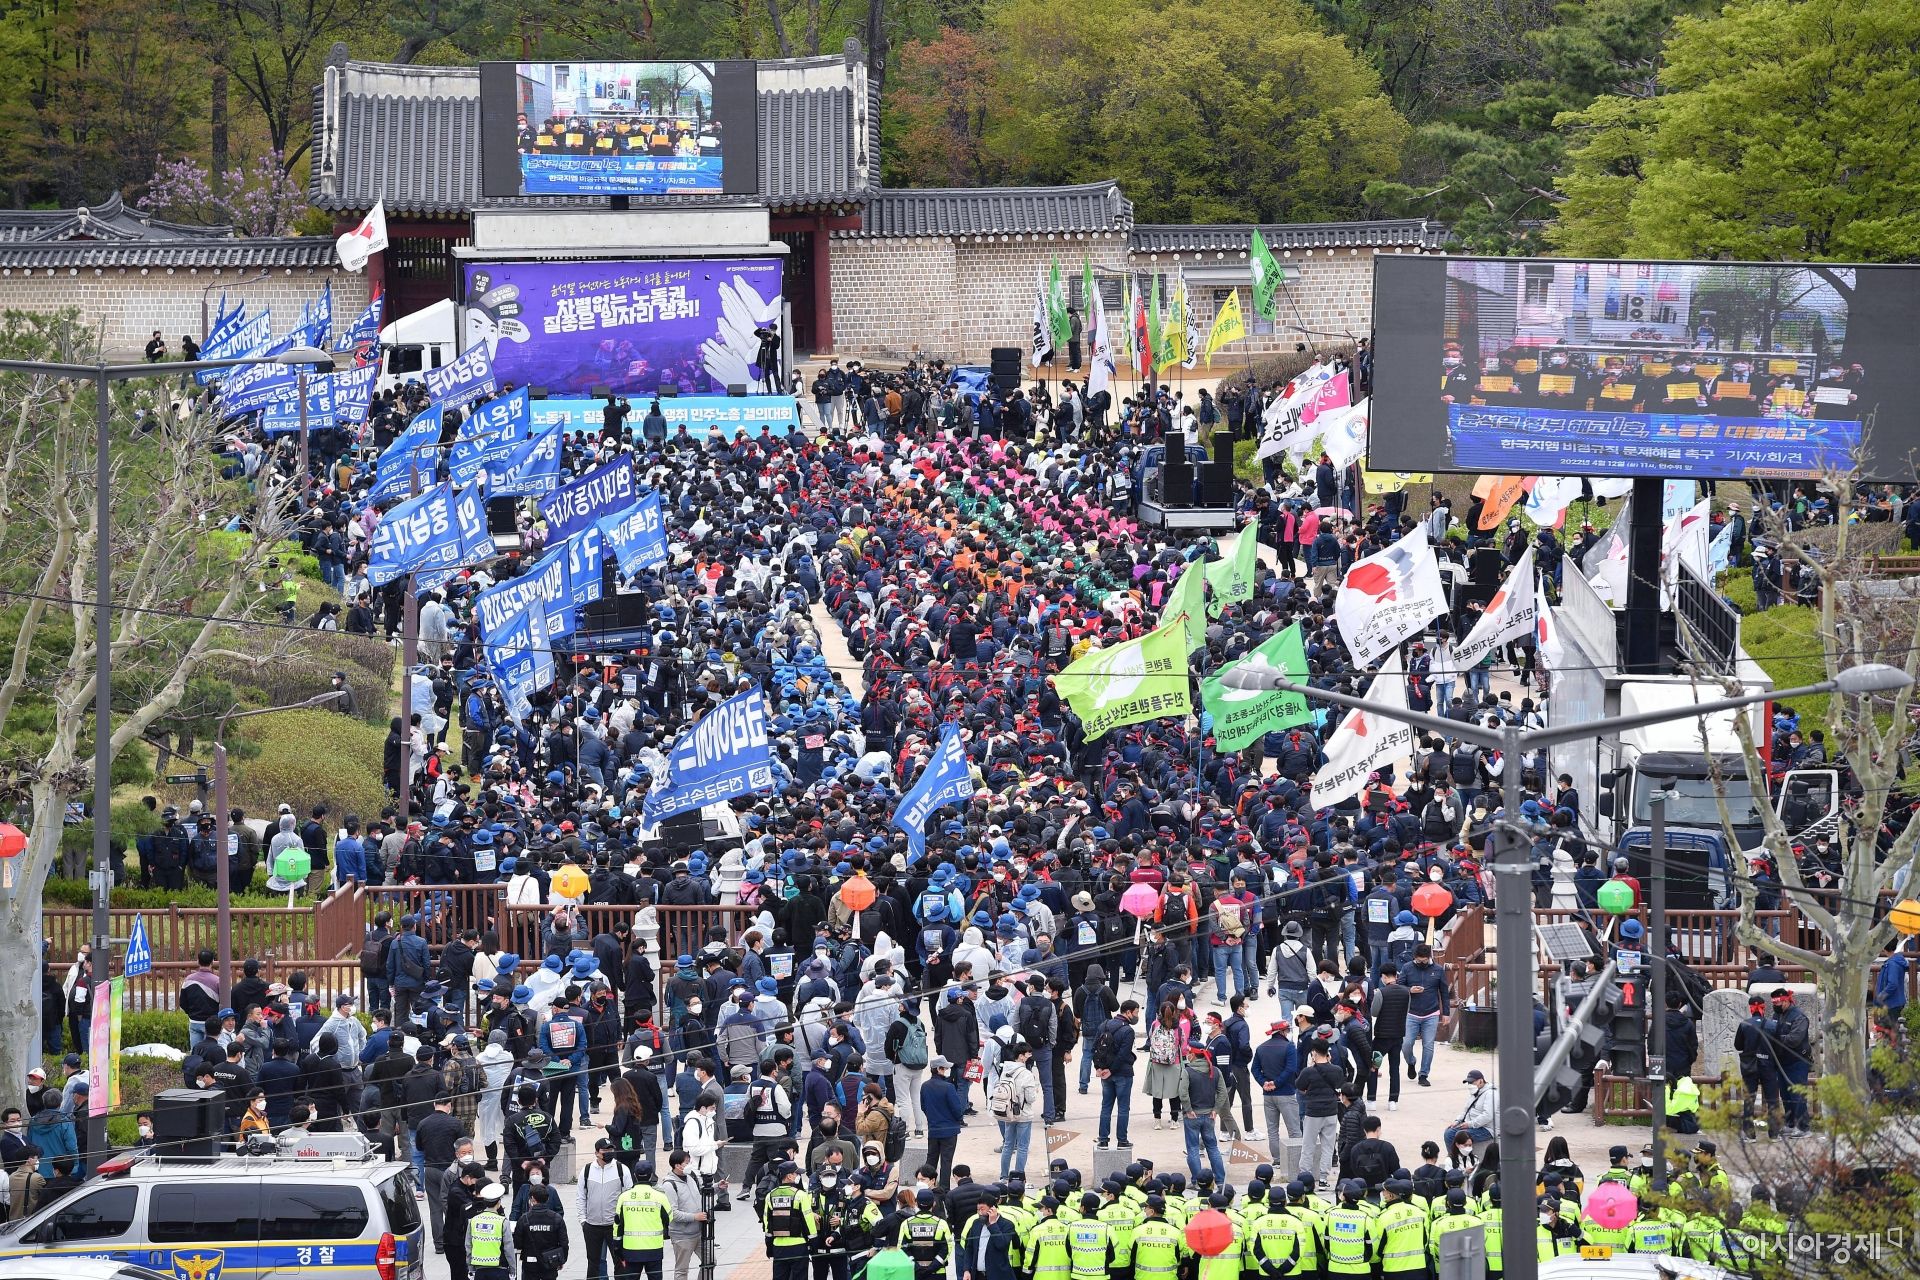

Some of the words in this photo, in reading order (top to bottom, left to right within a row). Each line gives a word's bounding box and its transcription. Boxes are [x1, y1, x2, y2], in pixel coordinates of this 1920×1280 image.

[613, 275, 641, 289] 노동자의
[557, 293, 628, 317] 차별없는
[632, 285, 686, 308] 노동권
[543, 312, 596, 334] 질좋은
[600, 303, 654, 328] 일자리
[658, 298, 700, 321] 쟁취!
[533, 410, 572, 425] 노동권
[690, 407, 741, 423] 민주노총
[743, 406, 793, 421] 결의대회
[1501, 439, 1560, 452] 한국지엠
[1562, 442, 1620, 456] 비정규직
[1623, 445, 1682, 460] 문제해결
[1685, 448, 1716, 461] 촉구
[1726, 450, 1803, 464] 기/자/회/견
[1560, 458, 1591, 466] 2022년
[128, 963, 150, 974] 횡단보도
[214, 1071, 237, 1080] Discovery
[1047, 1131, 1071, 1145] 61기-1
[297, 1148, 320, 1157] Teklite
[1232, 1148, 1259, 1162] 61기-3
[1394, 1223, 1420, 1233] POLICE
[297, 1246, 336, 1265] 경찰
